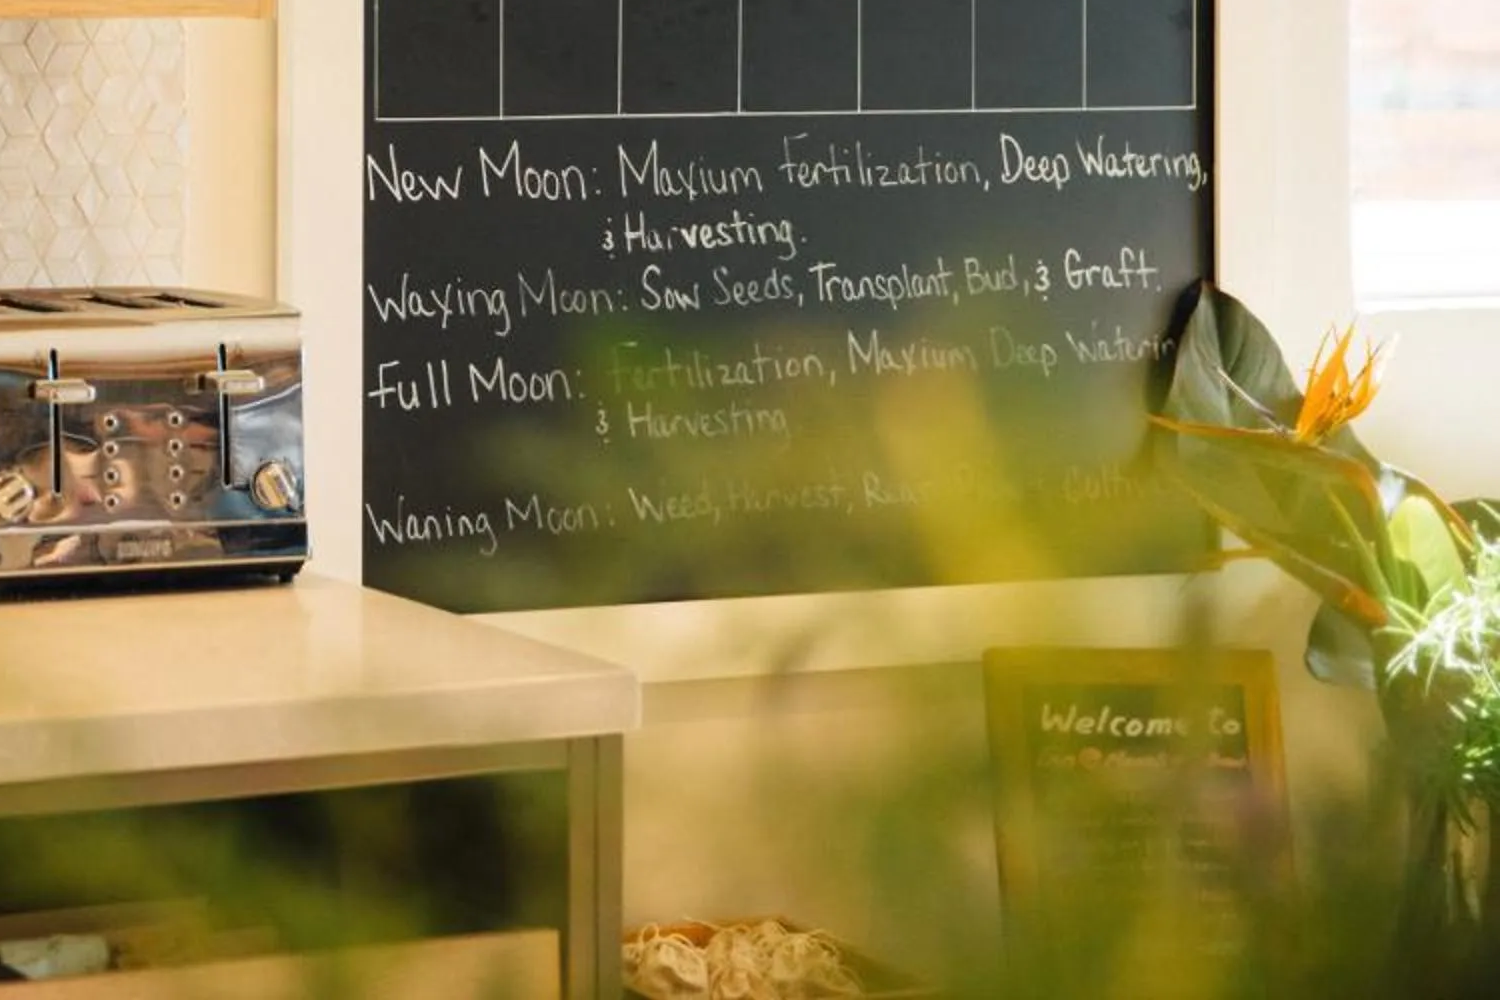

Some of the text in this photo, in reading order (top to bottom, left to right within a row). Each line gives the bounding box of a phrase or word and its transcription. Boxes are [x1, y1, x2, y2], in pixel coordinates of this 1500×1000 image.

[366, 132, 1209, 202] New Moon: Maxium Fertilization, Deep Watering,
[368, 271, 512, 337] Waxing
[517, 267, 629, 319] Moon:
[641, 264, 700, 312] Sow
[712, 264, 803, 308] Seeds,
[808, 256, 959, 311] Transplant,
[964, 254, 1031, 298] Bud,
[1063, 245, 1163, 293] Graft.
[367, 359, 452, 411] Full
[468, 357, 586, 403] Moon:
[989, 325, 1059, 378] Deep
[1064, 320, 1177, 364] Waterin
[365, 494, 498, 556] Waning
[505, 493, 616, 535] Moon:
[1040, 702, 1242, 738] Welcome to
